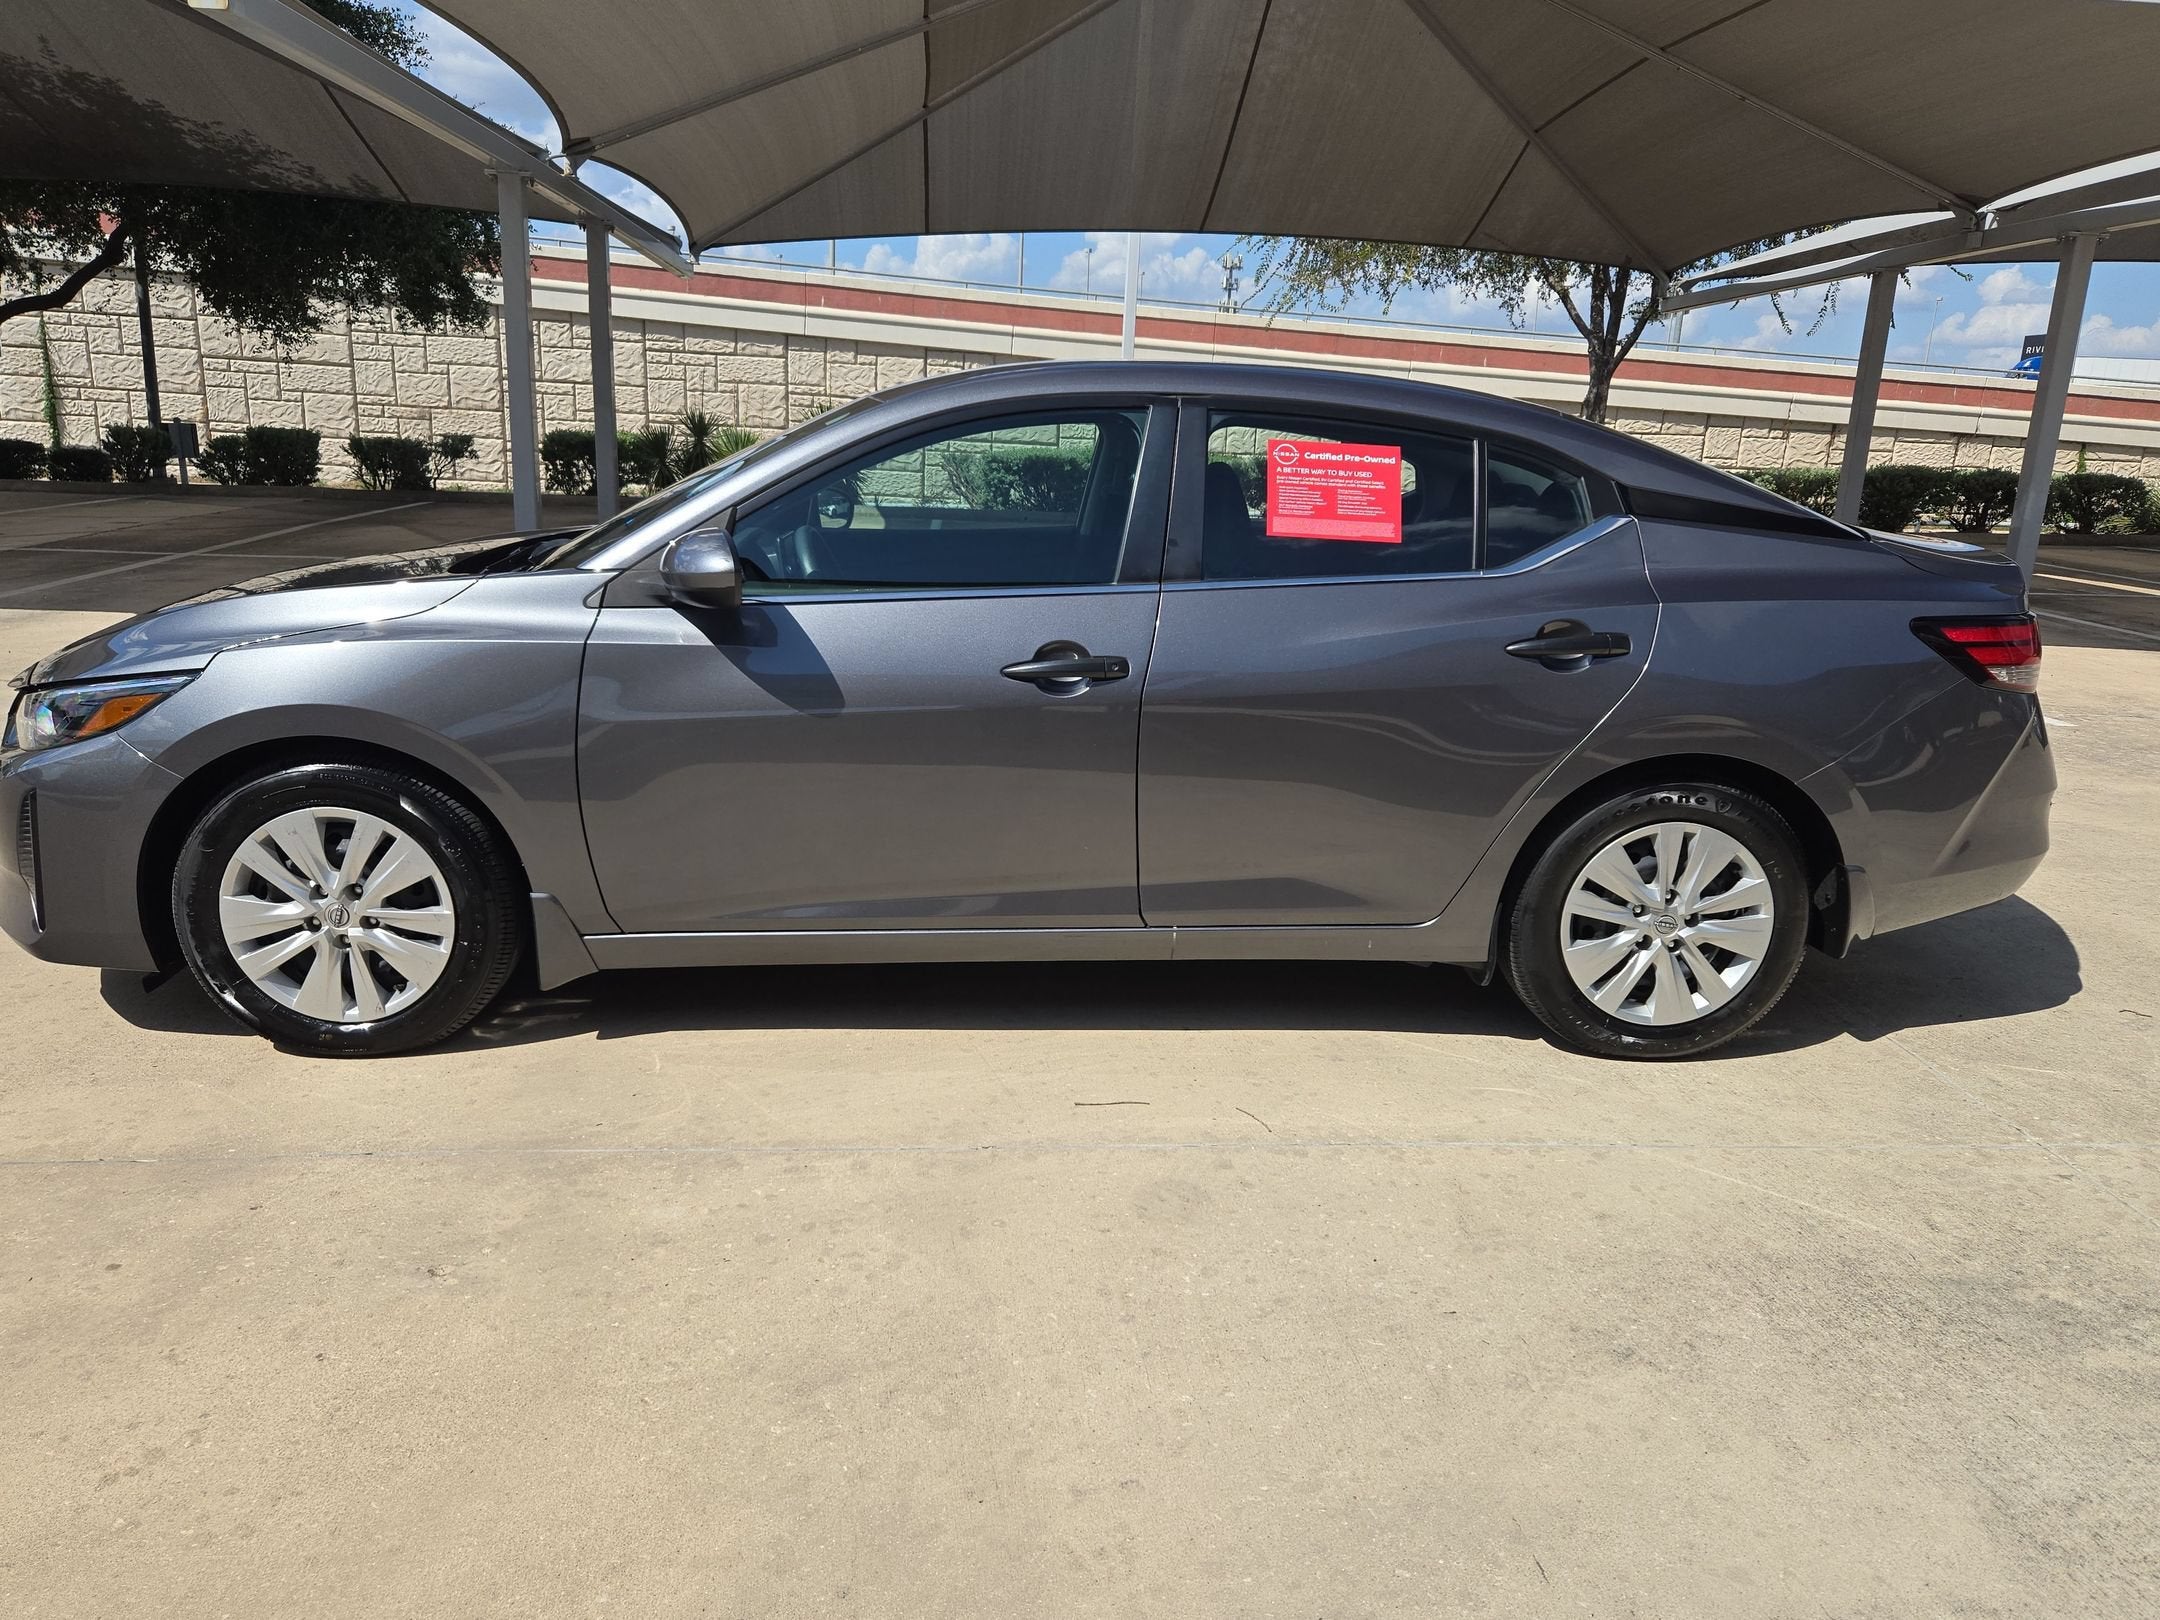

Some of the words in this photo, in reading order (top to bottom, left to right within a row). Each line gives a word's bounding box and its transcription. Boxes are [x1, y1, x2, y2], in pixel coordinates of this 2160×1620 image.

[2025, 346, 2044, 354] RIVI
[1304, 452, 1342, 461] Certified
[1344, 454, 1396, 464] Pre-Owned
[1283, 467, 1309, 475] BETTER
